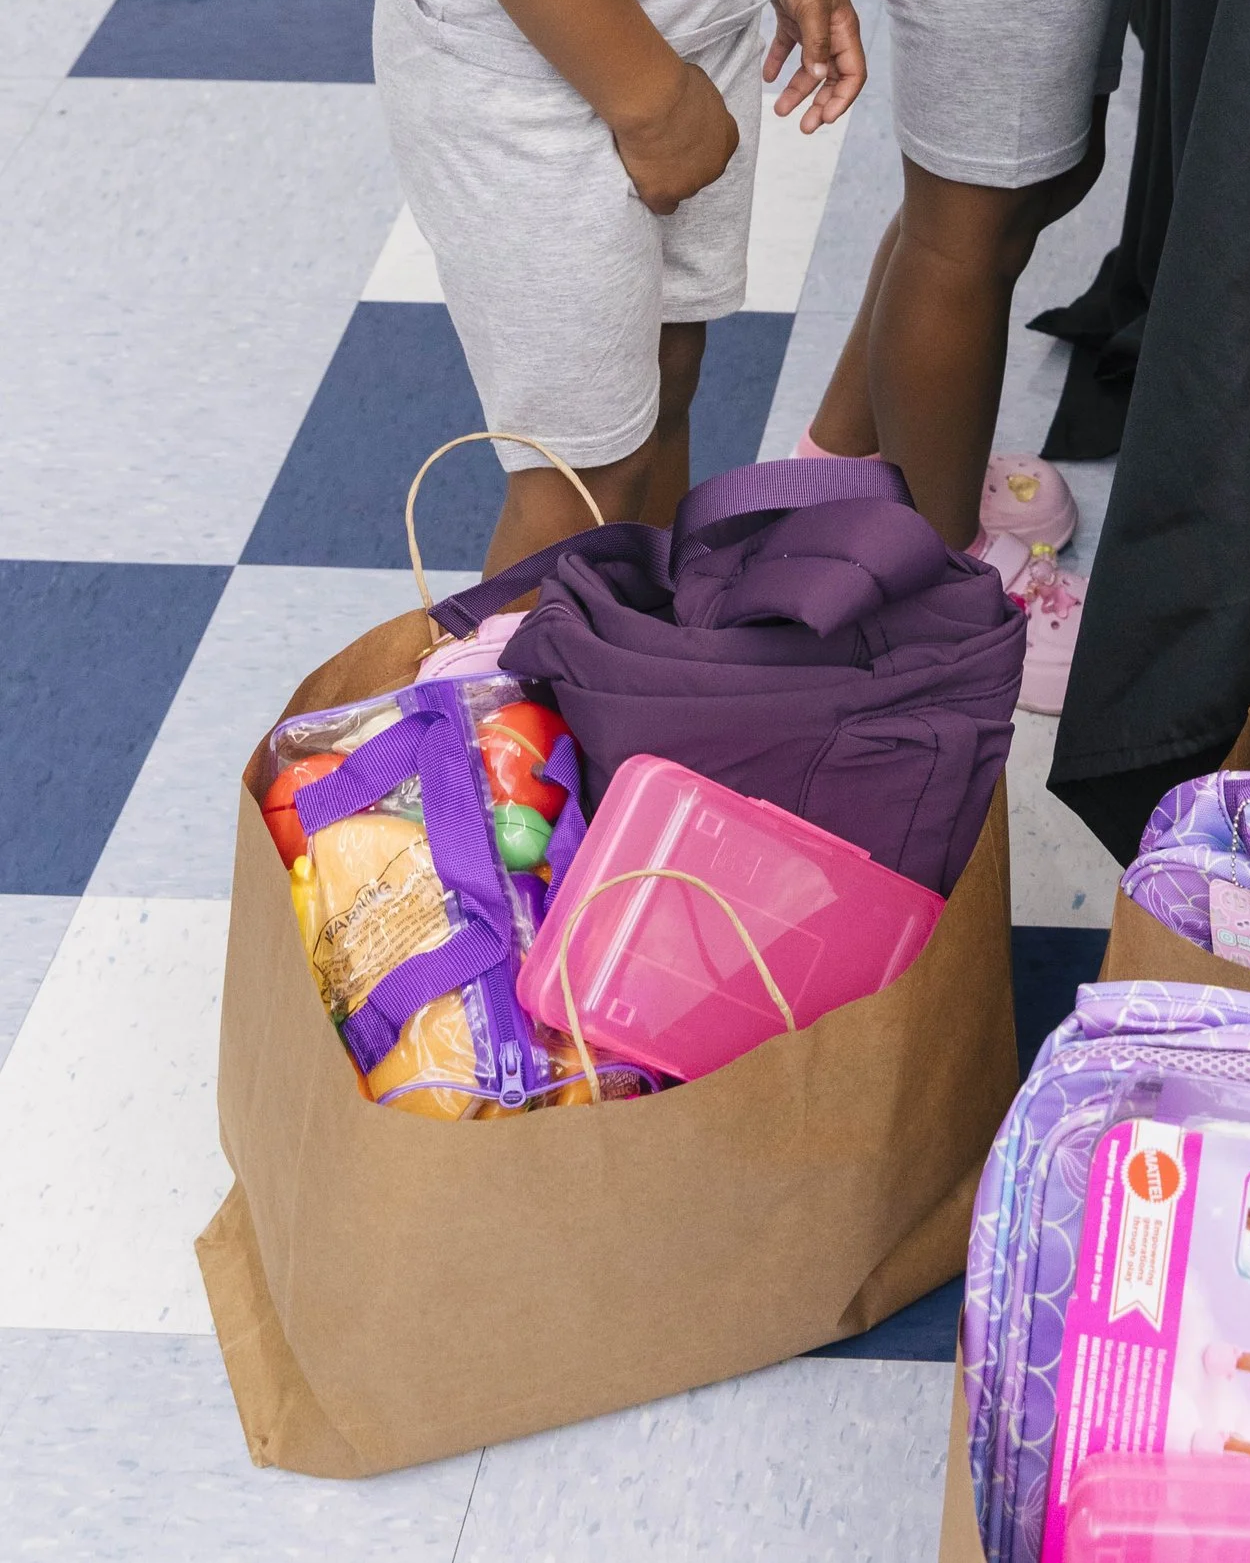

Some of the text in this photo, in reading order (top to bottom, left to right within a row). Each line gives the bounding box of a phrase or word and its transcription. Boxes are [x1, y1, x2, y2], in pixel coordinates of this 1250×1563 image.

[1144, 1148, 1164, 1203] MATTEL
[1128, 1216, 1141, 1257] through
[1137, 1217, 1151, 1281] generations
[1146, 1219, 1163, 1286] Empowering
